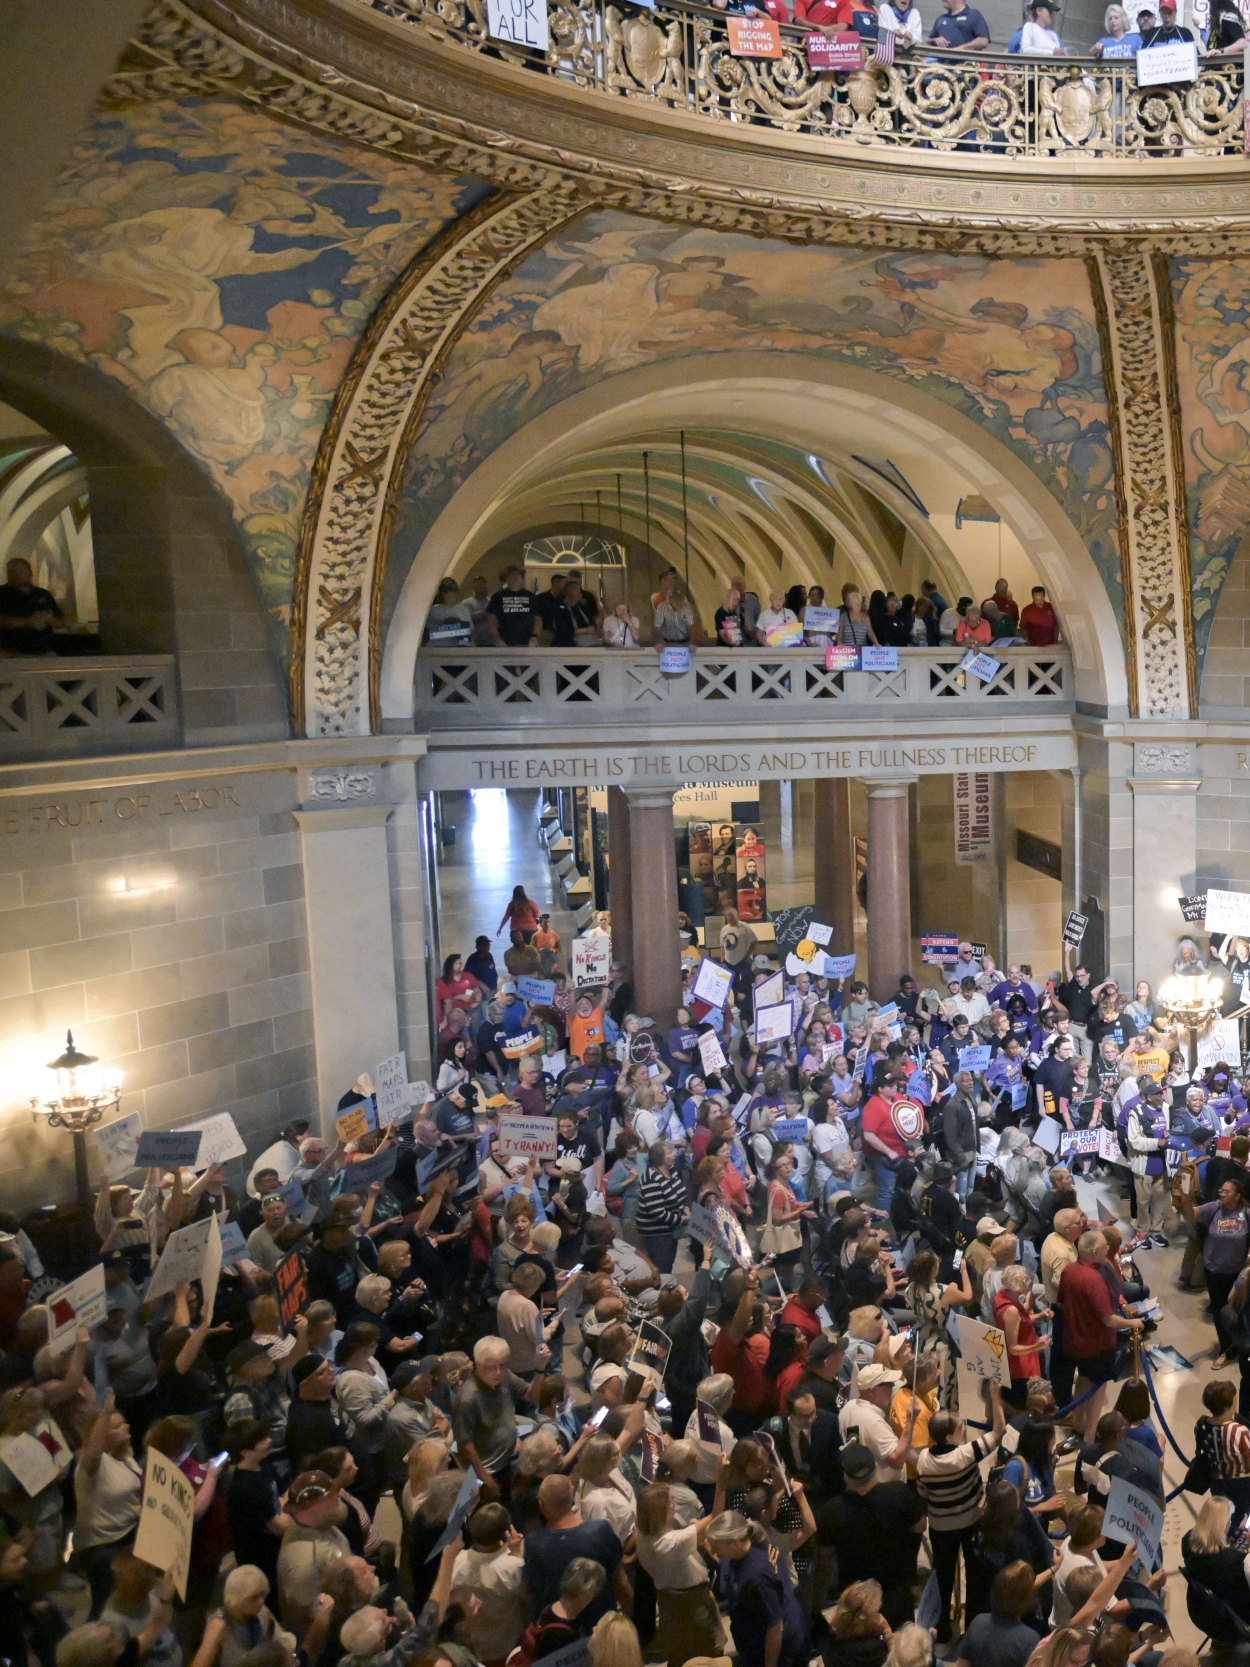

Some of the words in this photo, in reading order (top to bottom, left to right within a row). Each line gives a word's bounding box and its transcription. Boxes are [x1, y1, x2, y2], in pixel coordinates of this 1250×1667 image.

[498, 15, 538, 45] ALL
[742, 19, 764, 30] STOP
[738, 30, 772, 42] RIGGING
[738, 41, 757, 50] THE
[759, 42, 774, 51] MAP
[810, 43, 859, 52] SOLIDARITY
[666, 650, 687, 658] PEOPLE
[472, 760, 519, 780] THE
[526, 757, 599, 778] EARTH
[606, 757, 623, 776] IS
[628, 756, 672, 774] THE
[757, 752, 807, 771] AND
[811, 751, 851, 770] THE
[859, 748, 945, 768] FULLNESS
[950, 745, 1037, 765] THEREOF
[695, 791, 718, 802] Hall
[30, 799, 108, 832] FRUIT
[115, 795, 150, 820] OF
[160, 786, 241, 816] LABOR
[971, 772, 990, 839] Museum
[957, 803, 970, 853] Missouri
[1215, 892, 1239, 903] WHEN
[773, 908, 791, 931] STOP
[787, 919, 808, 946] NOW
[972, 946, 986, 955] EXIT
[833, 958, 851, 967] PEOPLE
[526, 979, 546, 991] PEOPLE
[505, 1030, 533, 1048] PEOPLE
[966, 1049, 985, 1058] PEOPLE
[379, 1057, 401, 1077] FAIR
[961, 1059, 990, 1068] POLITICIANS
[382, 1073, 404, 1091] MAPS
[381, 1089, 402, 1108] FAIR
[1063, 1130, 1099, 1140] PROTECT
[1080, 1135, 1097, 1145] OUR
[504, 1138, 555, 1152] TYRANNY!
[1078, 1142, 1099, 1152] VOTE!
[641, 1339, 658, 1356] FAIR
[152, 1464, 167, 1483] NO
[1127, 1493, 1156, 1525] PEOPLE
[1108, 1514, 1156, 1561] POLITICIANS
